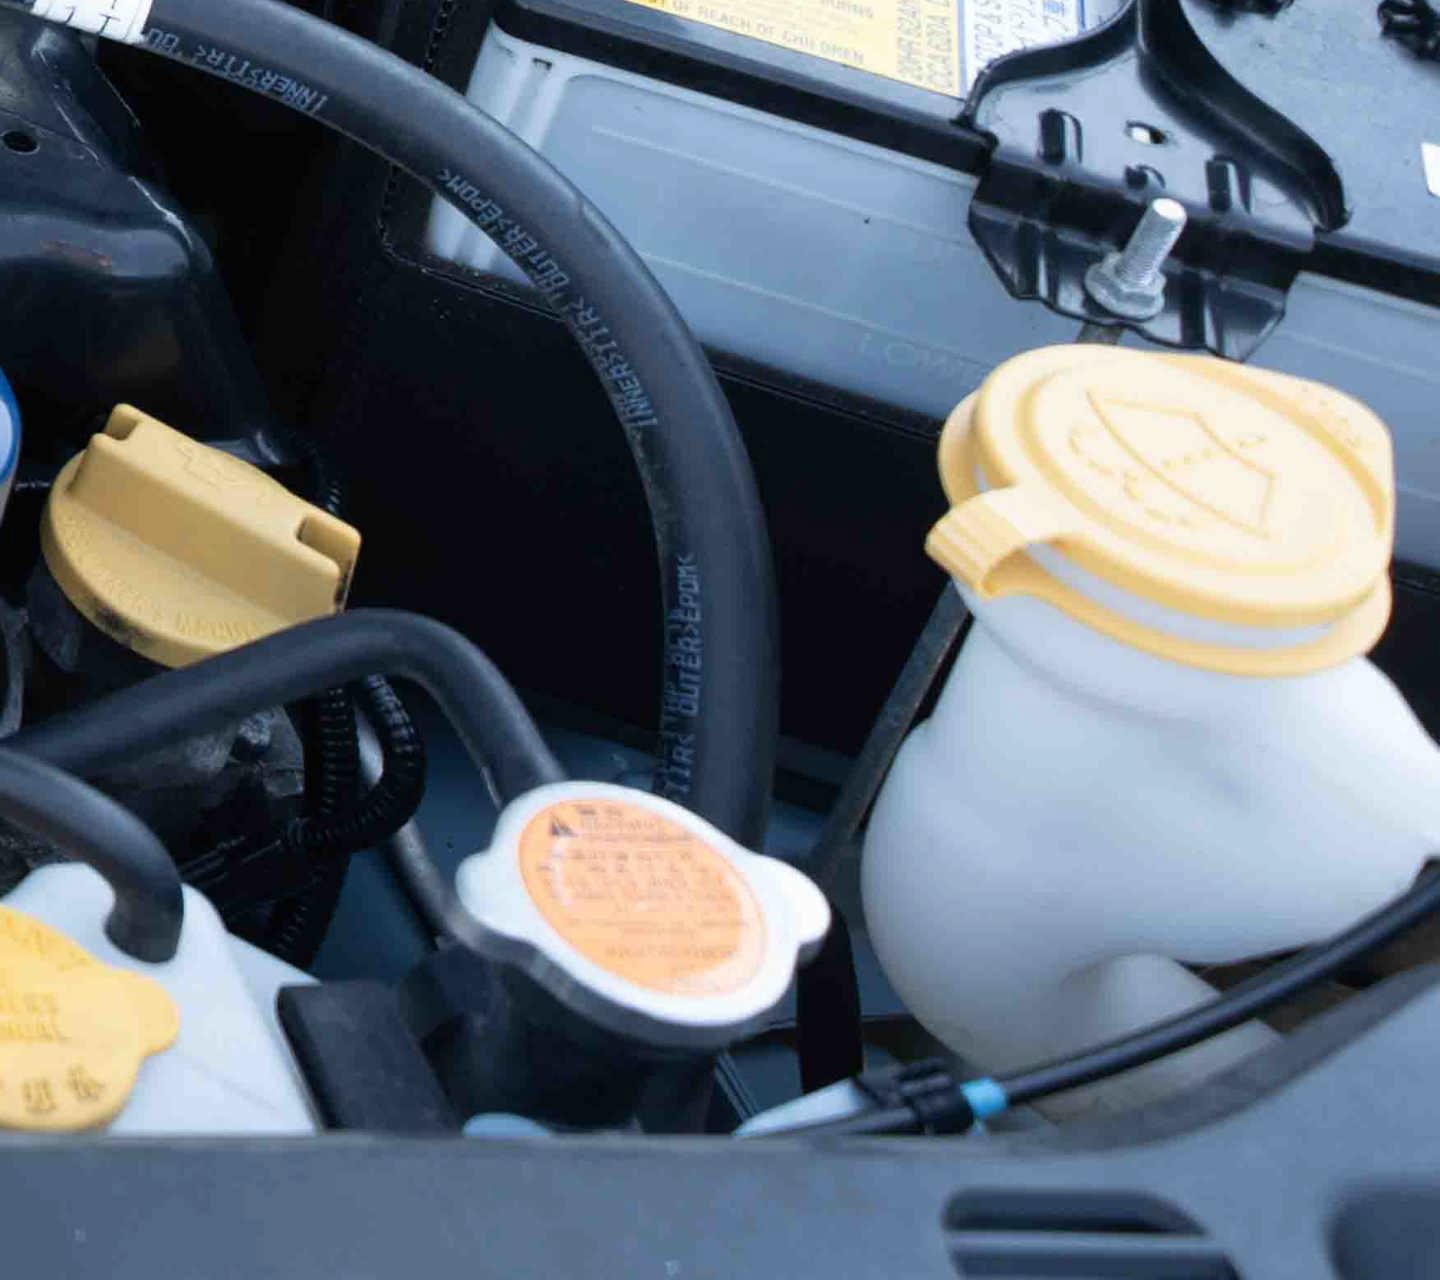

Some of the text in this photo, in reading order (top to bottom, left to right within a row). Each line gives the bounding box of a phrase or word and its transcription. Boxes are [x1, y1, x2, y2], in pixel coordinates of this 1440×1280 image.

[673, 0, 691, 13] OF
[698, 6, 750, 32] REACH
[756, 22, 776, 38] OF
[781, 31, 865, 67] CHILDREN
